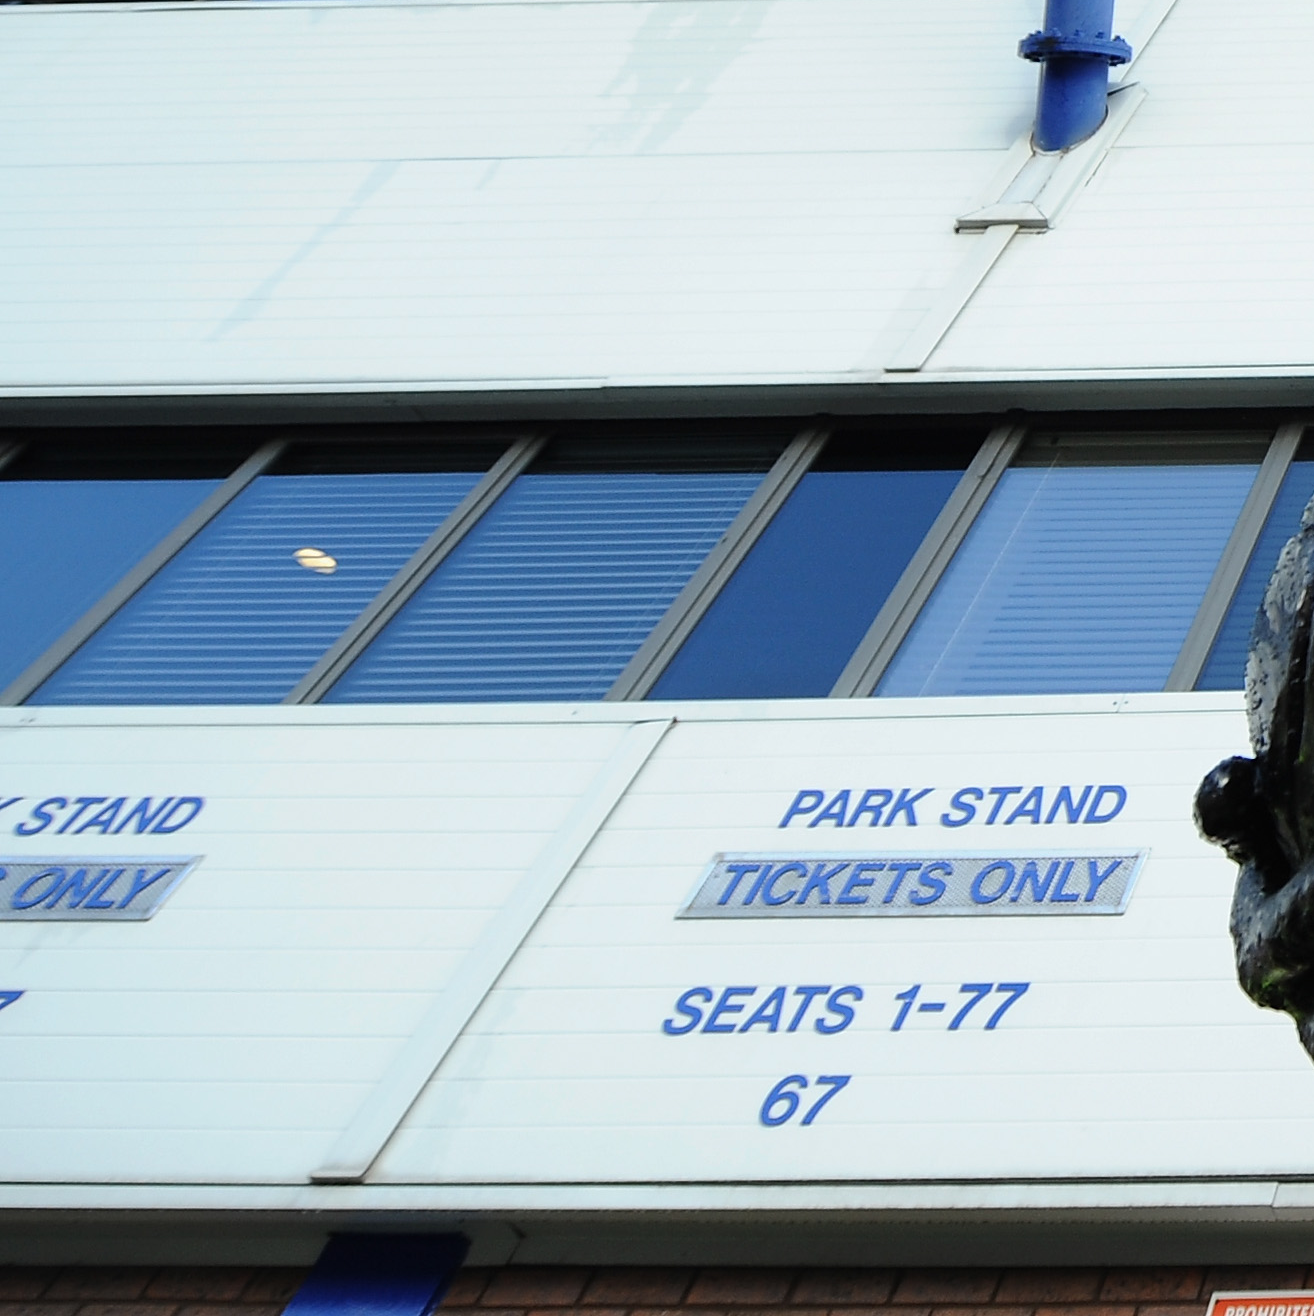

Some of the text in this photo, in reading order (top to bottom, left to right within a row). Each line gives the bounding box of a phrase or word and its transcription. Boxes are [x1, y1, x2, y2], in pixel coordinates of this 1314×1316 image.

[15, 796, 206, 835] STAND
[778, 785, 1128, 829] PARK STAND
[10, 867, 171, 910] ONLY
[716, 858, 1123, 906] TICKETS ONLY
[662, 981, 1031, 1035] SEATS 1-77
[758, 1074, 852, 1126] 67
